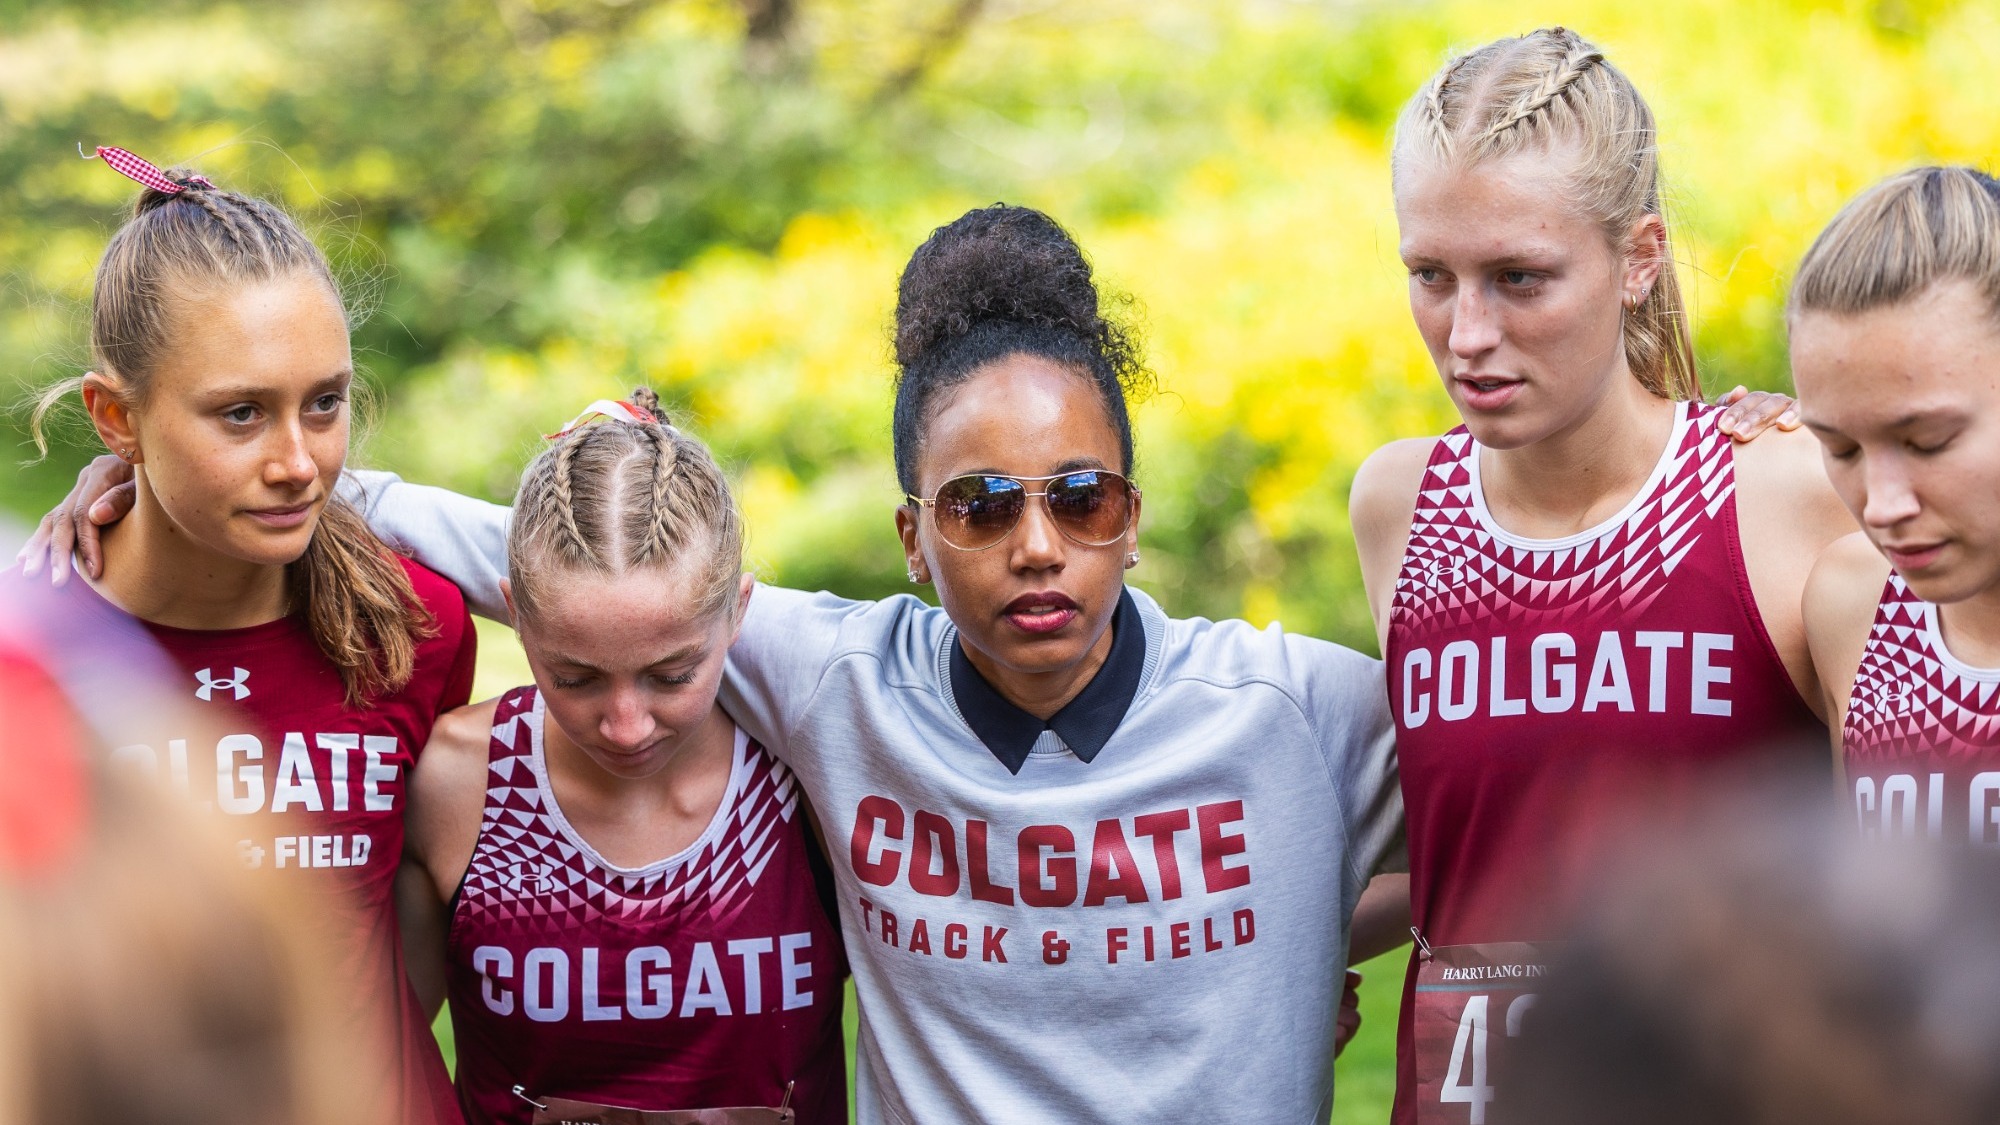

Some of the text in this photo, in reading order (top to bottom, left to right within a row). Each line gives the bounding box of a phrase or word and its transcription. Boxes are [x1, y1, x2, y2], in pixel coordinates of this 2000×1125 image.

[1403, 630, 1734, 729] COLGATE
[108, 731, 399, 815] LGATE
[274, 833, 372, 869] FIELD
[851, 795, 1251, 908] COLGATE
[859, 896, 1256, 966] TRACK & FIELD
[1442, 966, 1485, 980] HARRY
[1487, 965, 1522, 979] LANG
[473, 931, 814, 1022] COLGATE
[1440, 993, 1538, 1125] 4
